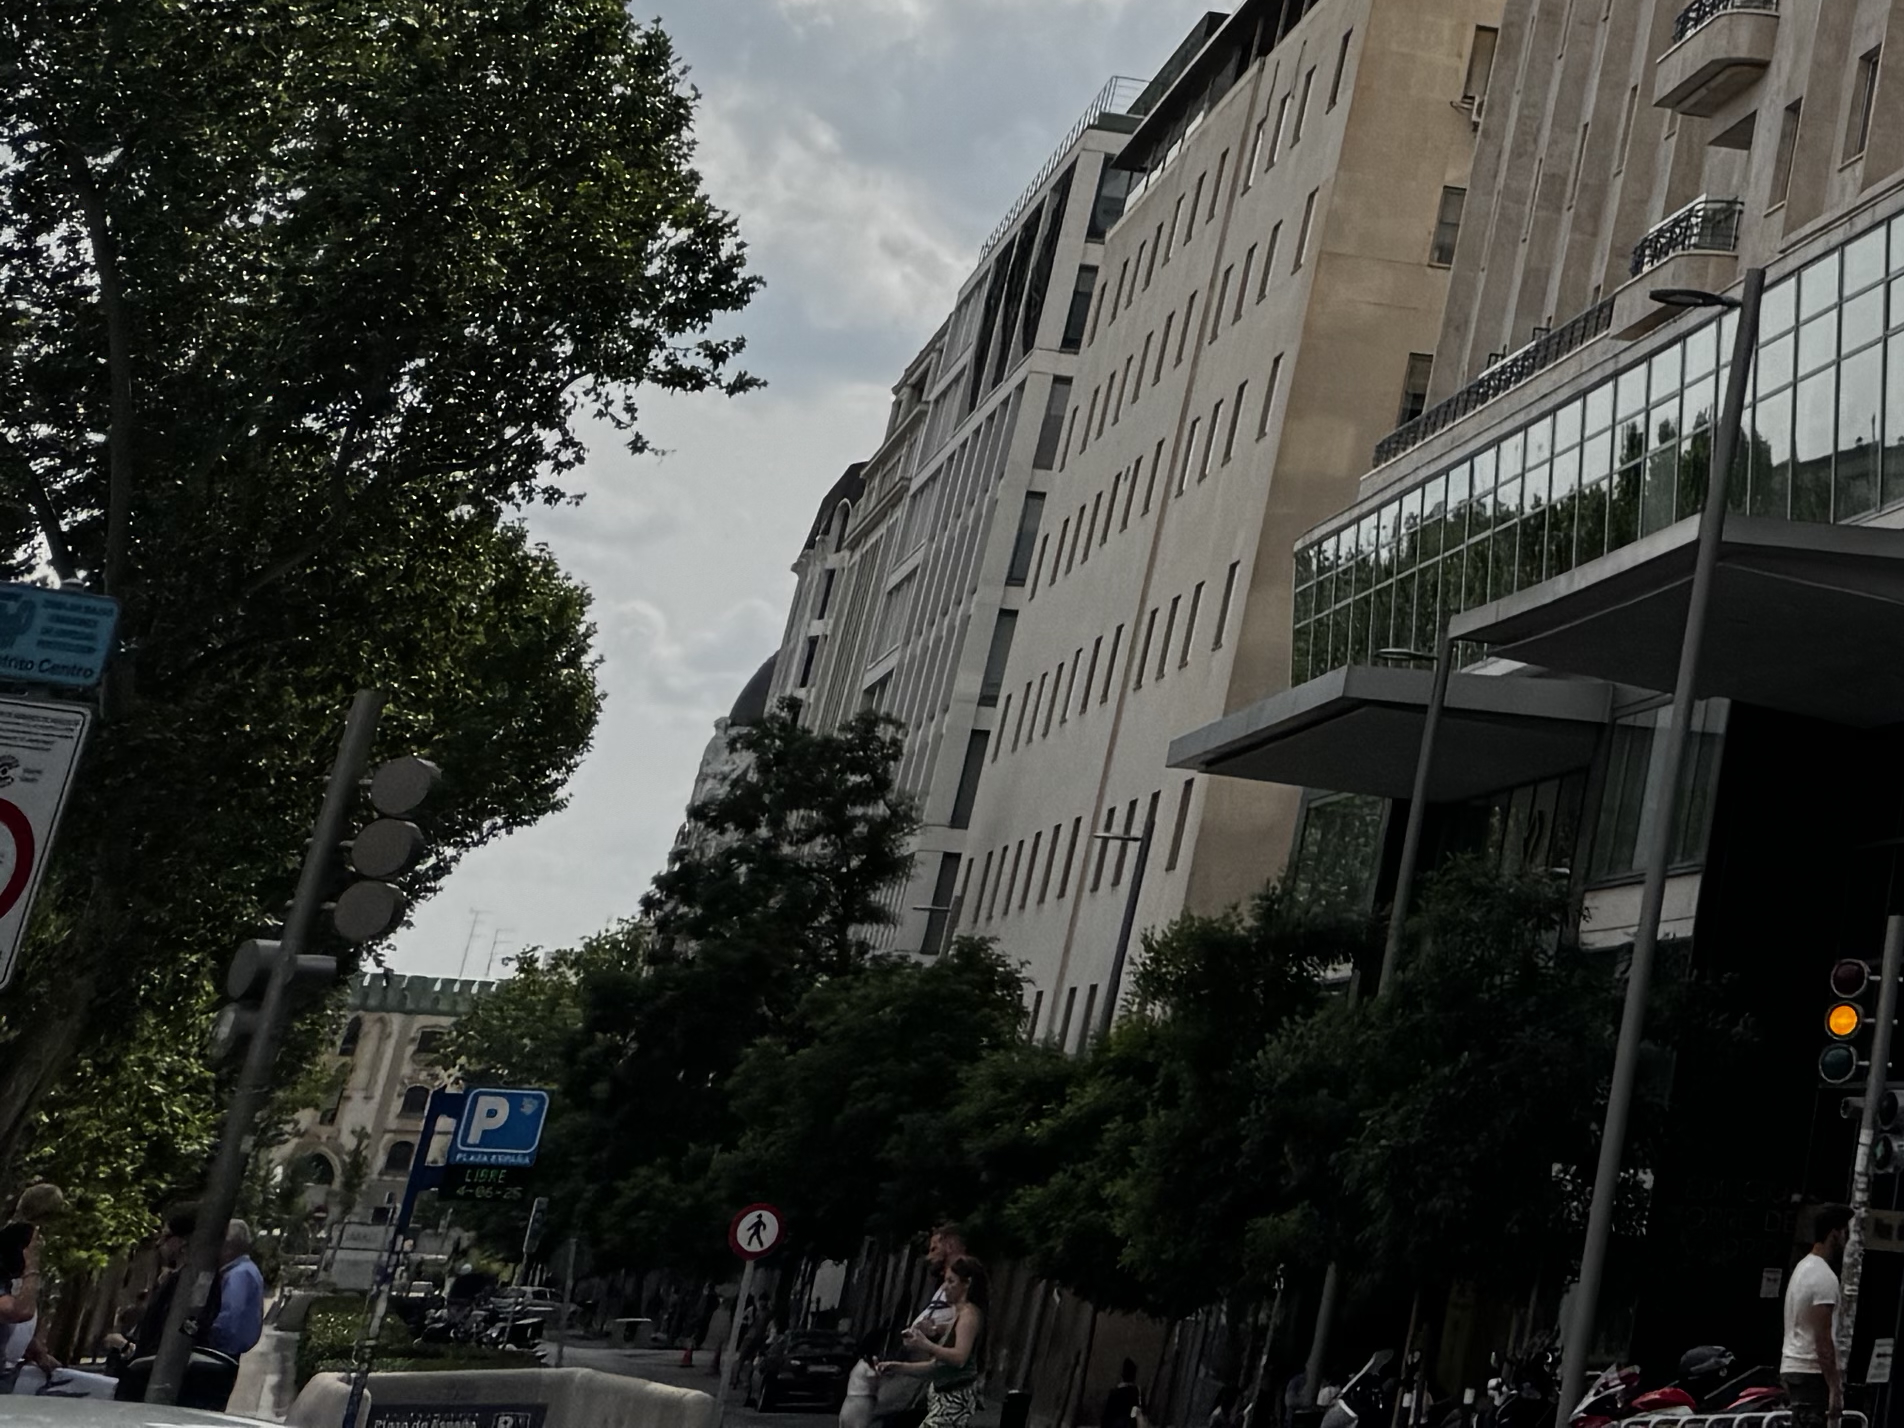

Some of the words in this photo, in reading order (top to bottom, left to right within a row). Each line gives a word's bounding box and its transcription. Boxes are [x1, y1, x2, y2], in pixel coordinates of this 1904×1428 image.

[39, 659, 94, 679] Centro
[467, 1095, 510, 1144] P
[465, 1169, 507, 1184] LIBRE
